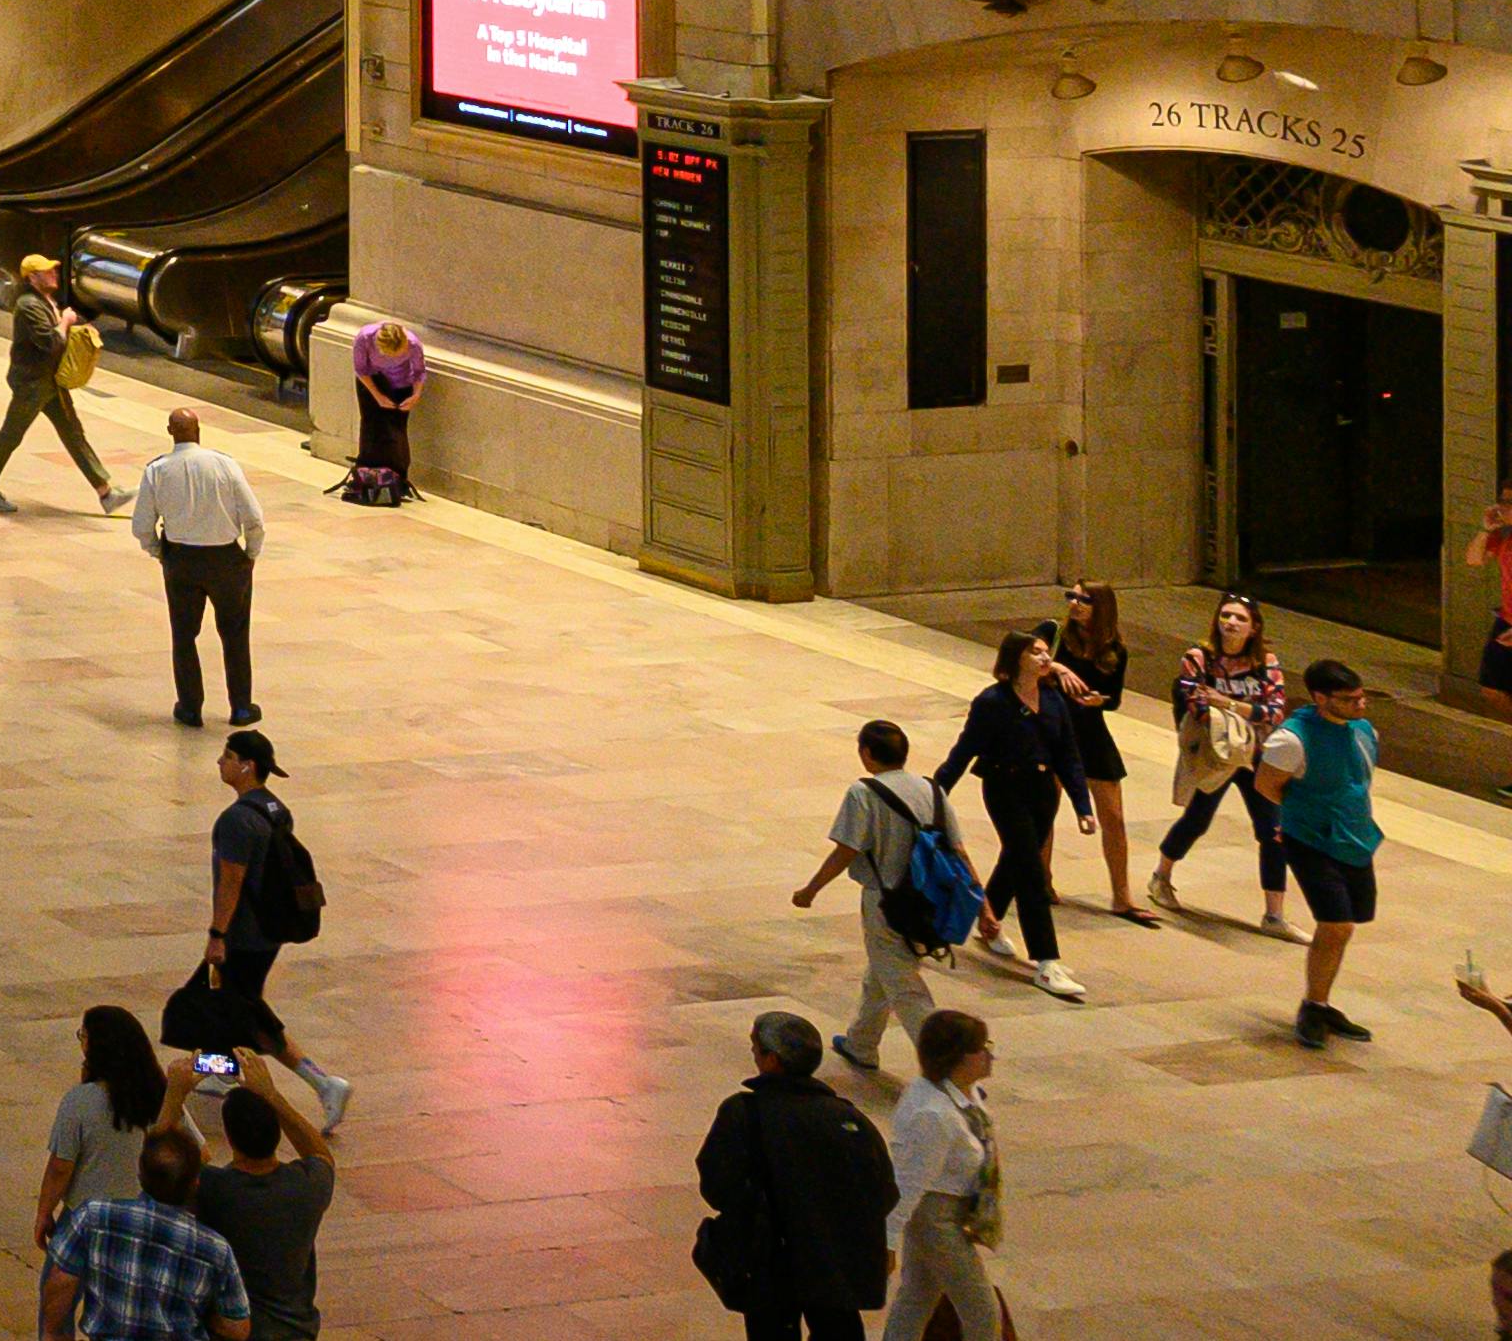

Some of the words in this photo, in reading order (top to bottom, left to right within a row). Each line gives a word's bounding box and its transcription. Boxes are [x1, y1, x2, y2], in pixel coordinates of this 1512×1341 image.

[476, 23, 488, 41] A
[489, 25, 514, 48] Top
[516, 29, 527, 47] 5
[528, 31, 588, 57] Hospital
[503, 49, 527, 68] the
[529, 54, 578, 77] Nation
[657, 115, 695, 133] TRACK
[701, 124, 715, 136] 26
[1149, 102, 1181, 127] 26
[1190, 102, 1322, 148] TRACKS
[1331, 127, 1366, 159] 25
[652, 166, 670, 179] NEW
[705, 158, 719, 171] PK
